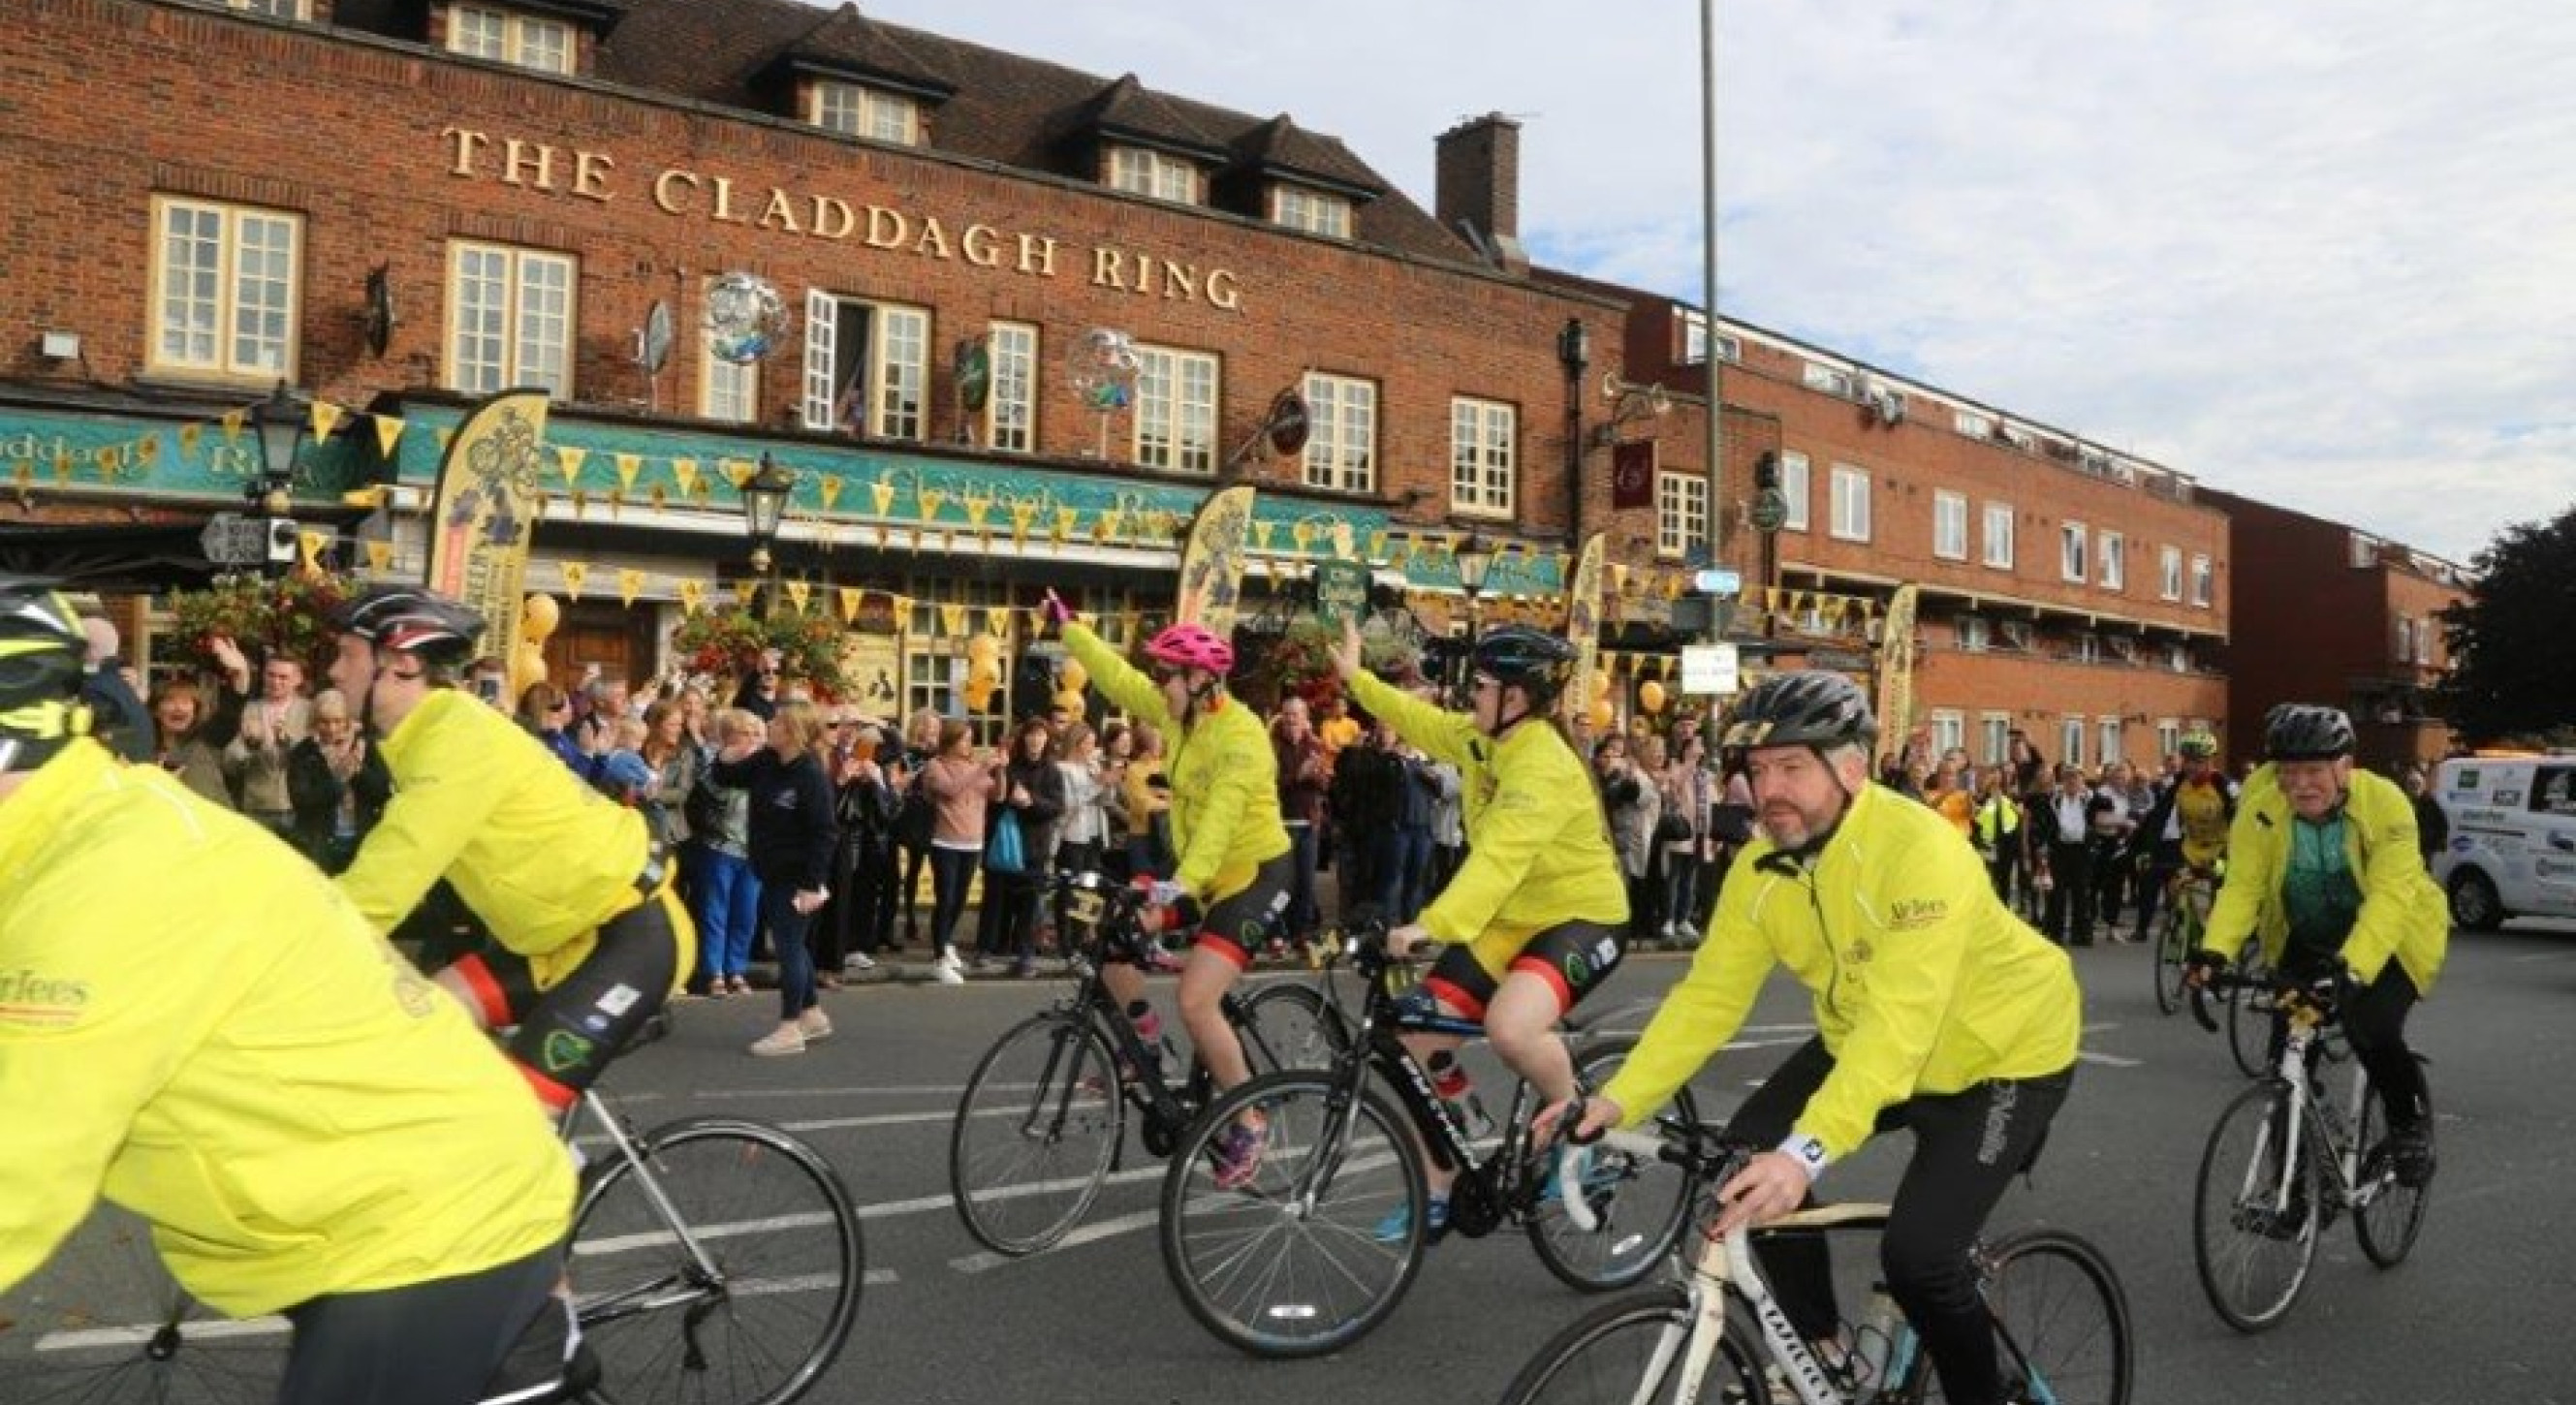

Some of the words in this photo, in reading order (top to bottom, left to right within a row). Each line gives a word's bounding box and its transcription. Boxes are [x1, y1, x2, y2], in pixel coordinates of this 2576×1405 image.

[442, 126, 617, 202] THE
[652, 169, 1056, 277] CLADDAGH
[1092, 246, 1240, 310] RING
